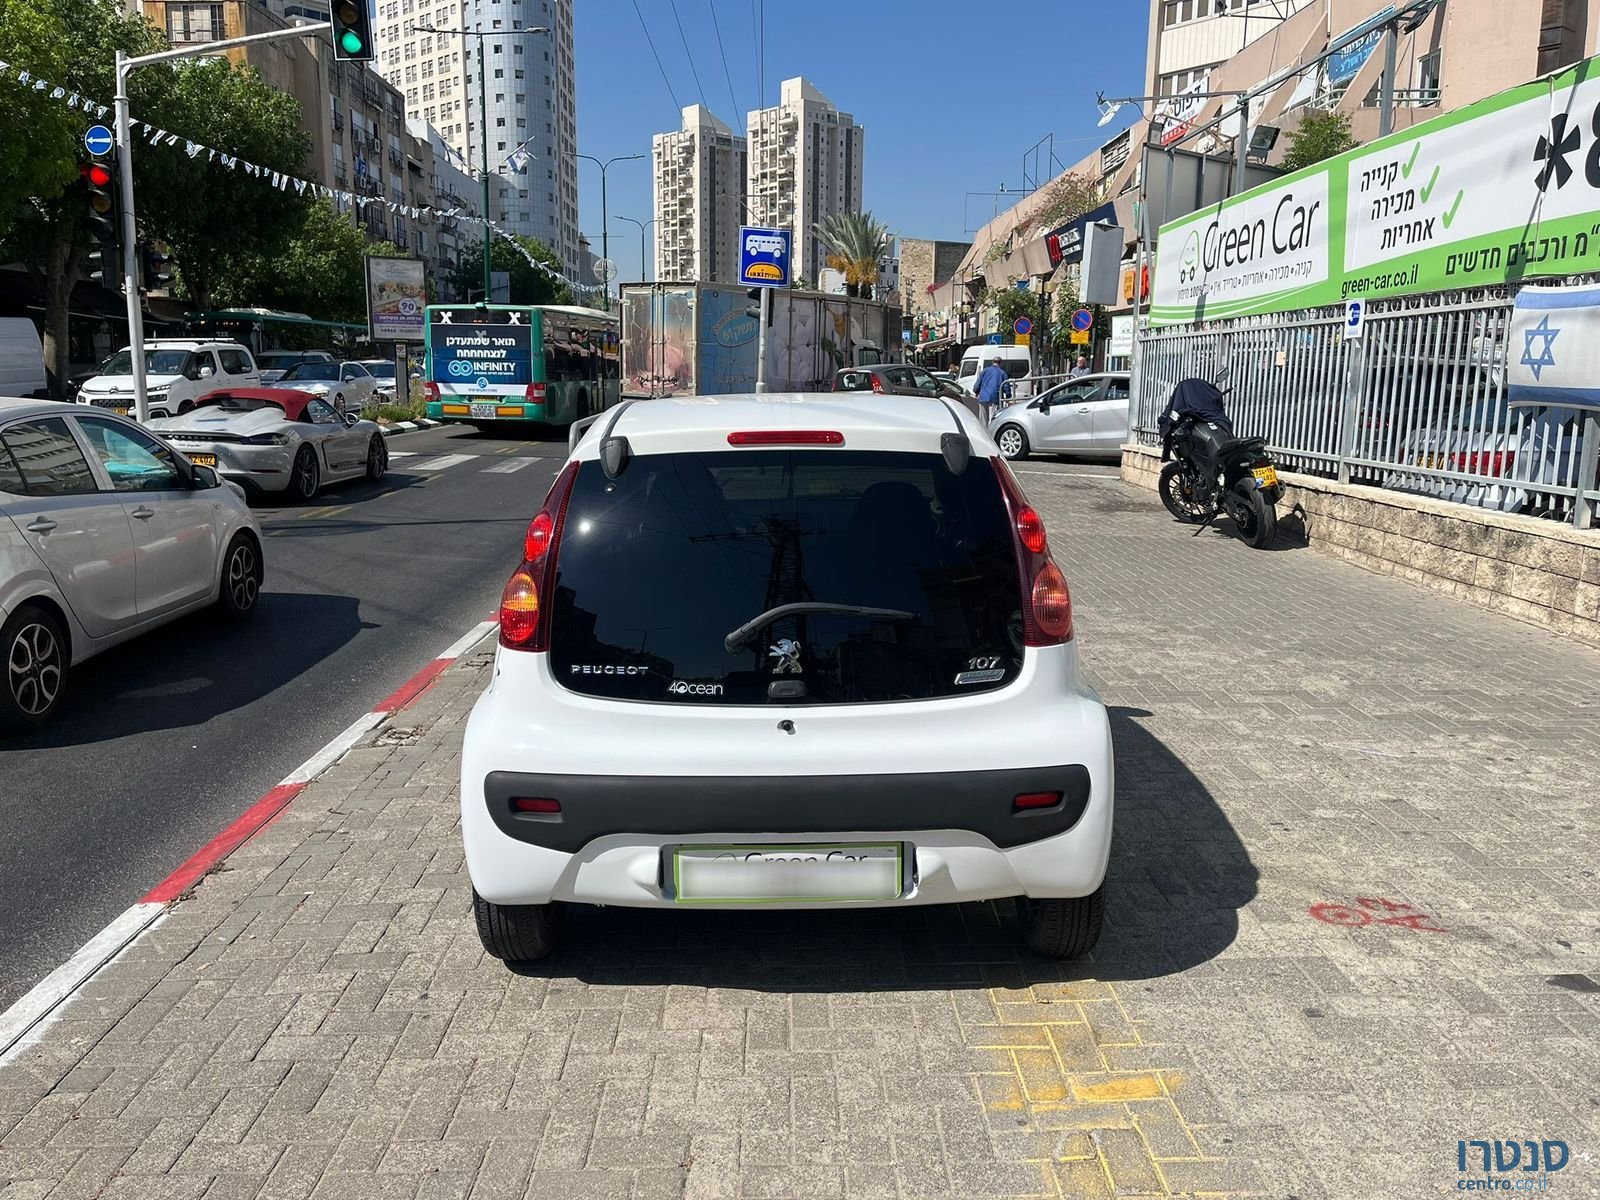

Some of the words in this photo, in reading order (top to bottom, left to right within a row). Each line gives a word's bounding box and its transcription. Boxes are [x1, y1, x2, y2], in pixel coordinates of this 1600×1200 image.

[1361, 161, 1399, 192] קנייה
[1371, 189, 1415, 221] מכירה
[1203, 218, 1266, 273] Green
[1272, 194, 1320, 255] Car
[1381, 217, 1435, 250] אחריות
[1507, 235, 1567, 266] ורכבים
[1294, 260, 1313, 279] קניה
[1445, 247, 1500, 276] חדשים
[1242, 270, 1265, 288] אחריות
[1268, 265, 1289, 281] מכירה
[1341, 264, 1419, 298] green-car.co.il
[401, 302, 414, 311] 90
[446, 337, 489, 347] שמתעדכן
[492, 337, 516, 346] תואר
[456, 349, 507, 358] לנצחחחחח
[473, 362, 516, 372] INFINITY
[571, 664, 649, 675] PEUGEOT
[968, 656, 1000, 670] 107
